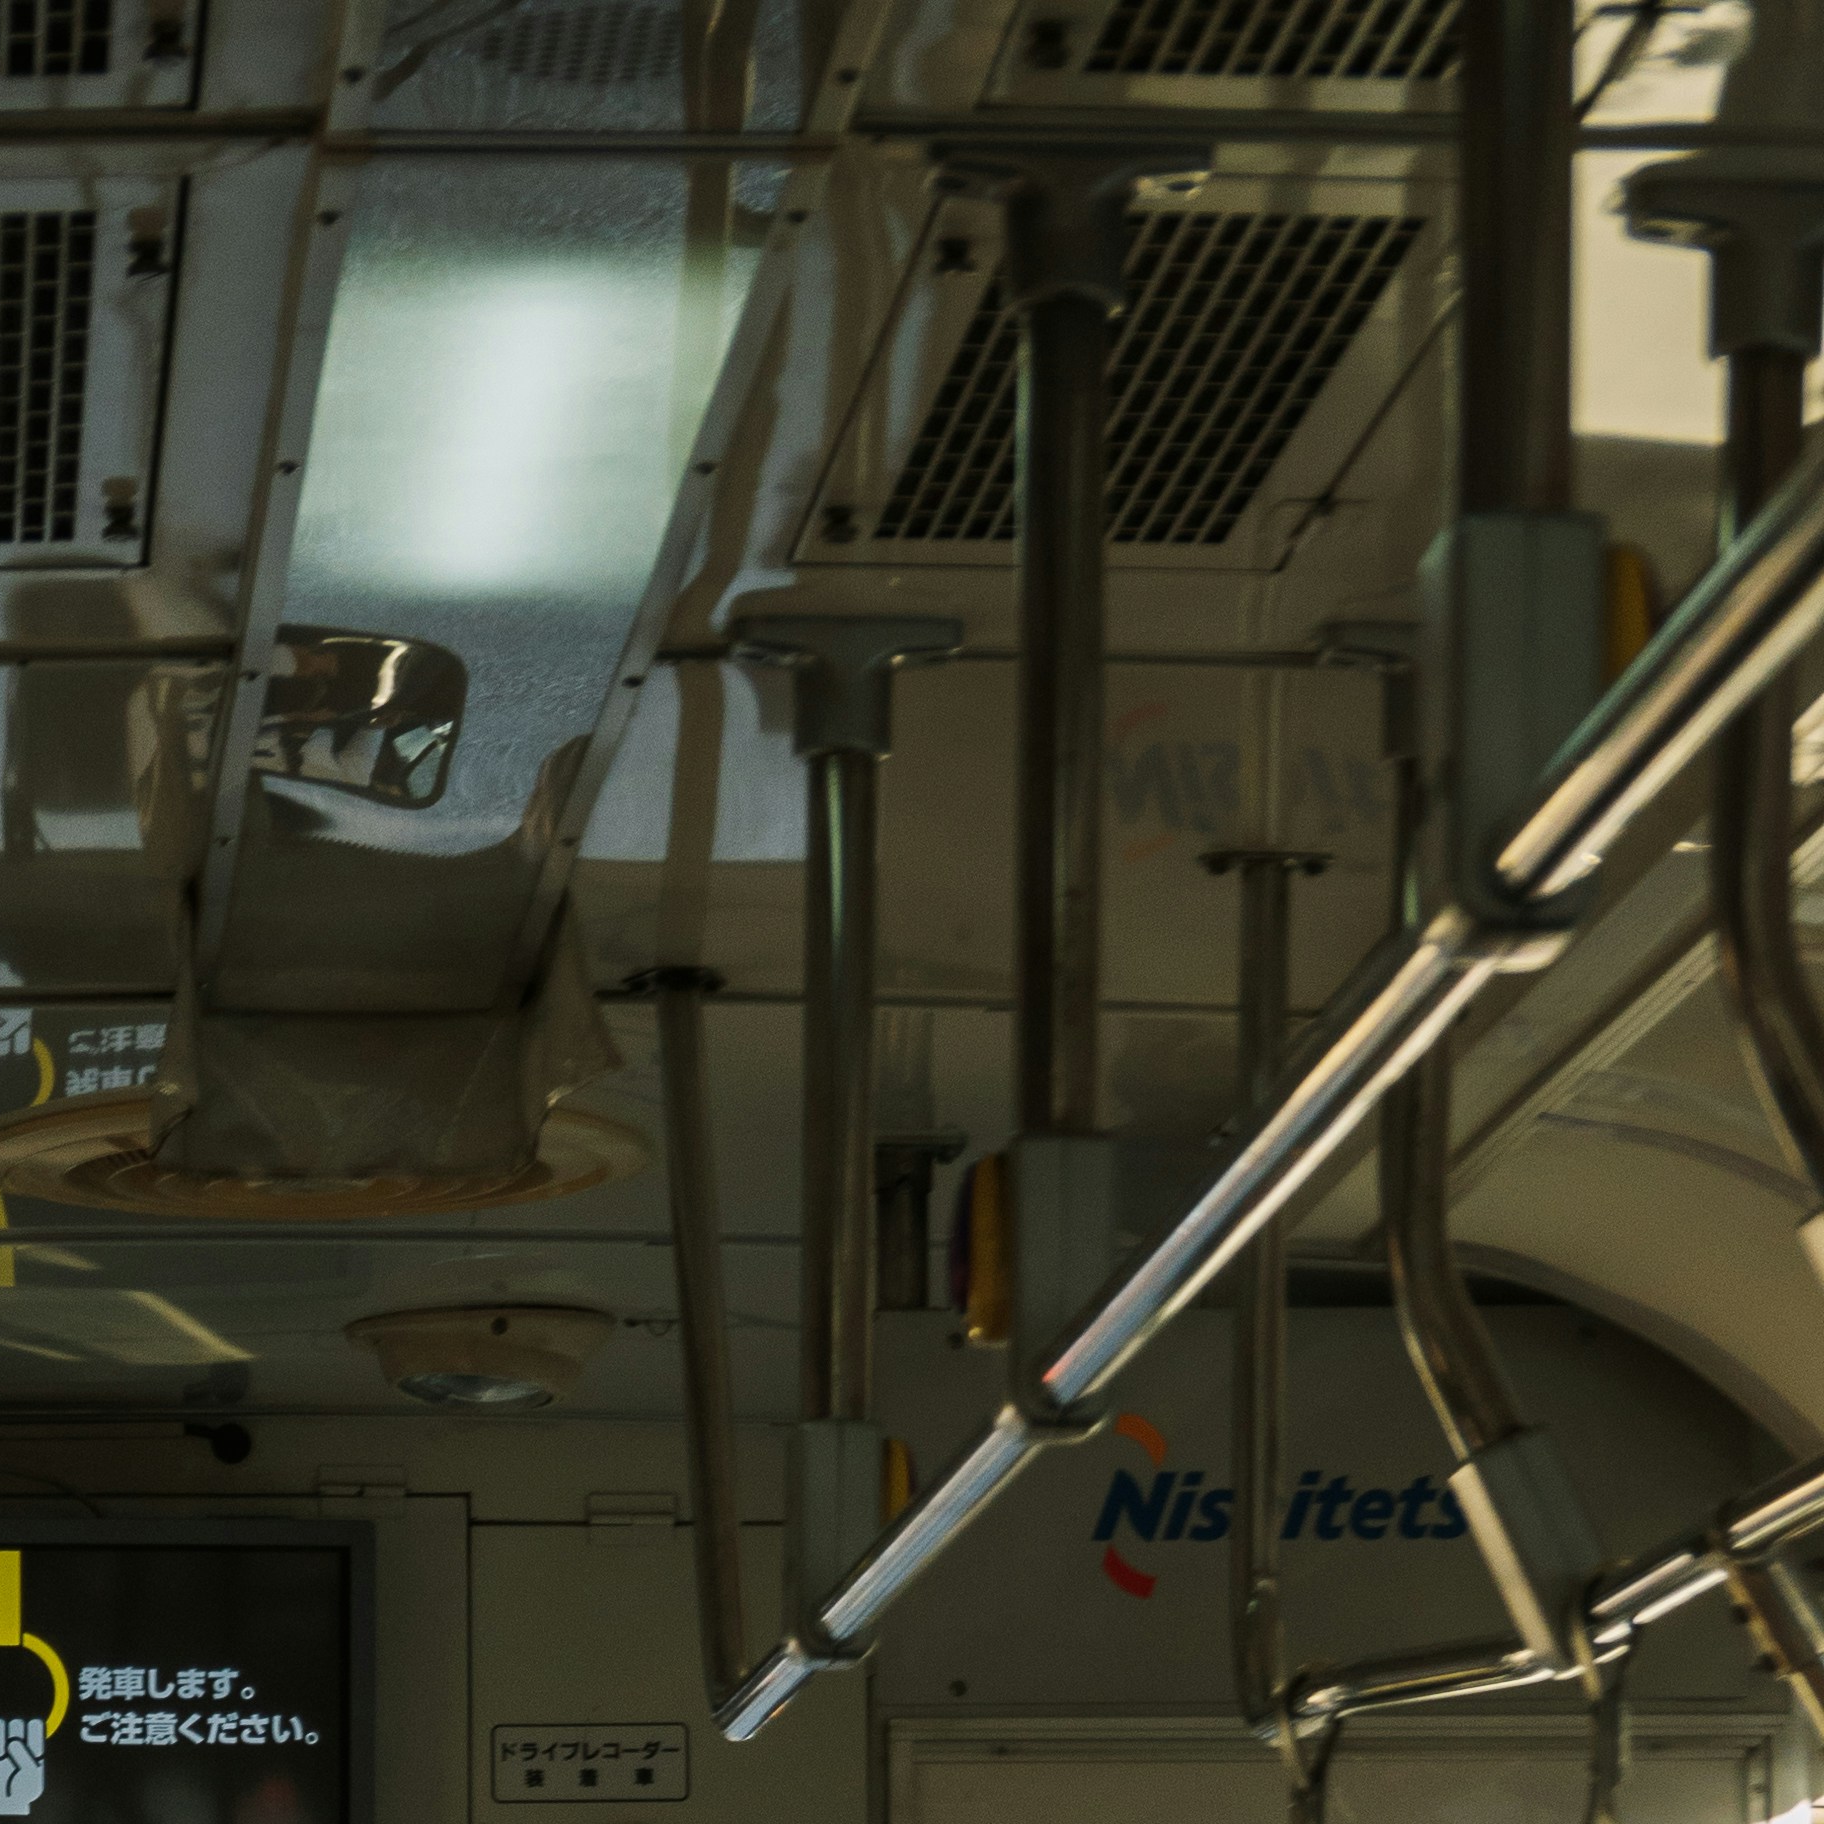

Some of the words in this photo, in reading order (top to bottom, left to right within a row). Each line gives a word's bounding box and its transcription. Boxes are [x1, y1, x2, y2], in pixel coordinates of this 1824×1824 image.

[1091, 1469, 1472, 1542] Nisitets
[78, 1668, 256, 1702] 発車します。
[79, 1713, 321, 1748] ご注意ください。
[500, 1740, 681, 1762] ドライブレコーダー
